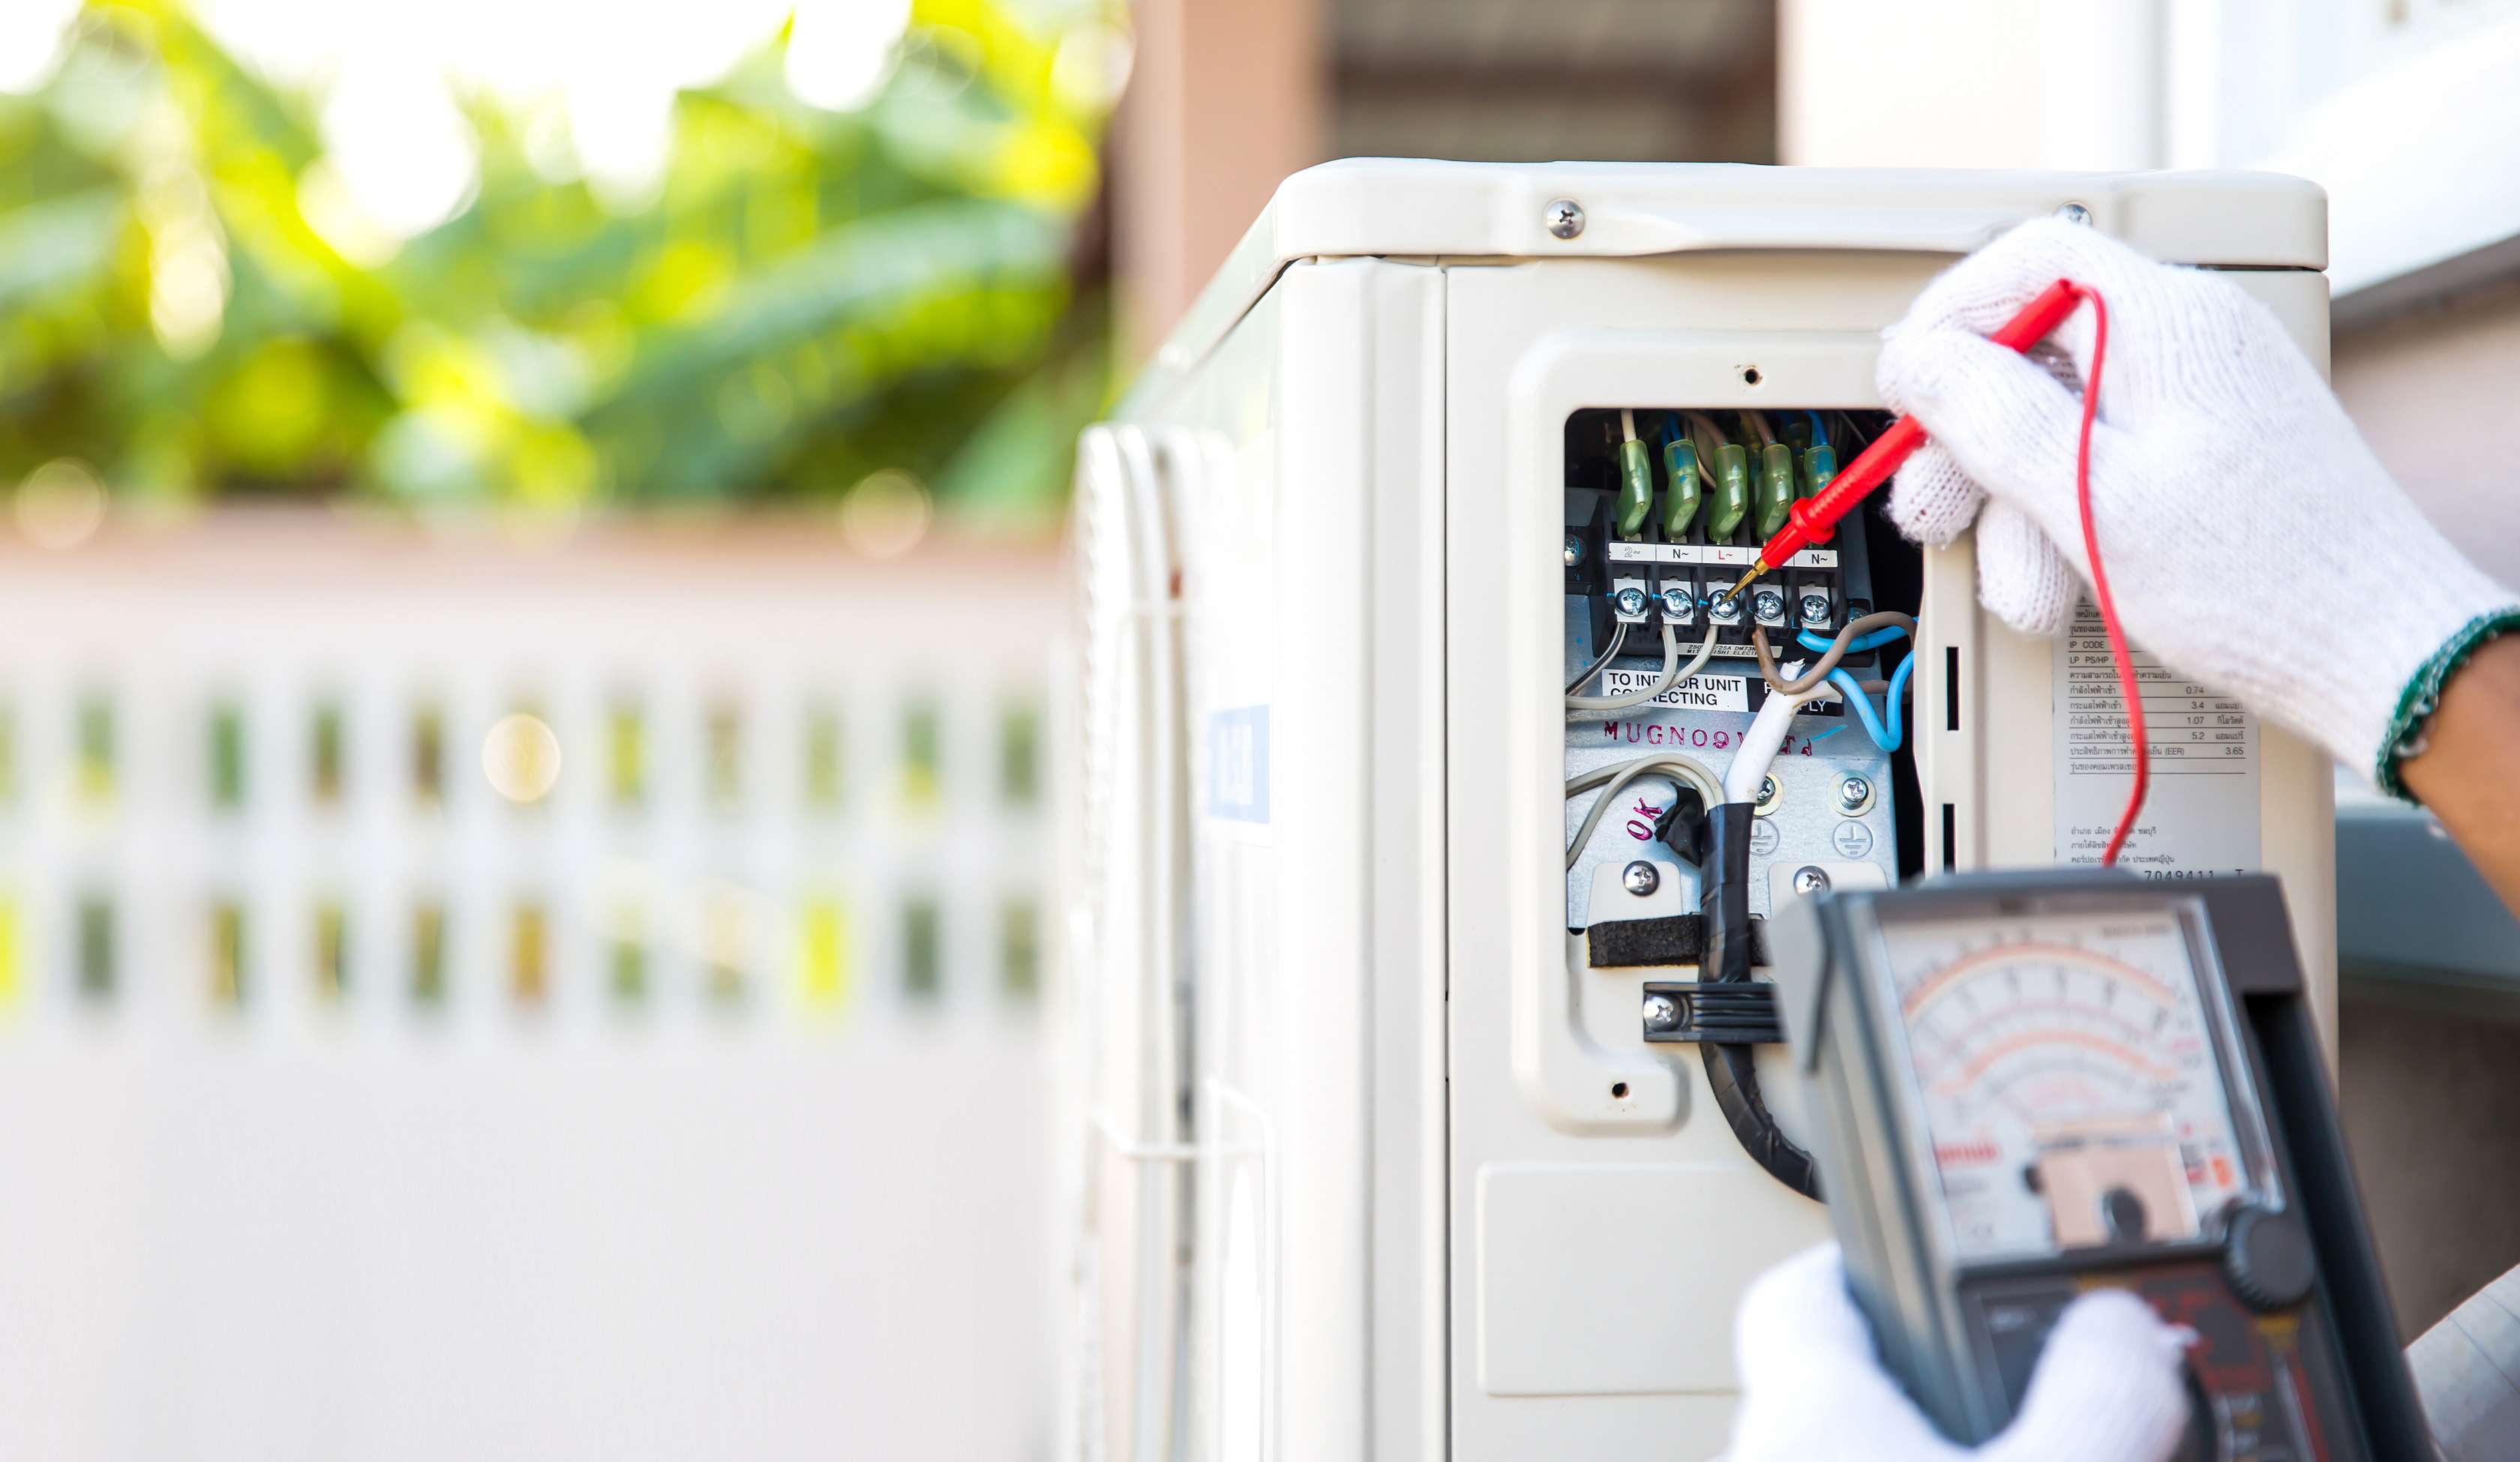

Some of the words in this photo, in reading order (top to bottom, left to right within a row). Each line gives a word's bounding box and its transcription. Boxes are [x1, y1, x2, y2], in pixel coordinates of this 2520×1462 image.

[1609, 673, 1630, 685] TO
[1705, 679, 1741, 691] UNIT
[2186, 686, 2204, 694] 0.74
[2187, 716, 2204, 724] 1.07
[2192, 732, 2205, 740] 5.2
[2165, 747, 2186, 756] (EER)
[2225, 747, 2244, 755] 3.65
[1627, 797, 1663, 840] OK
